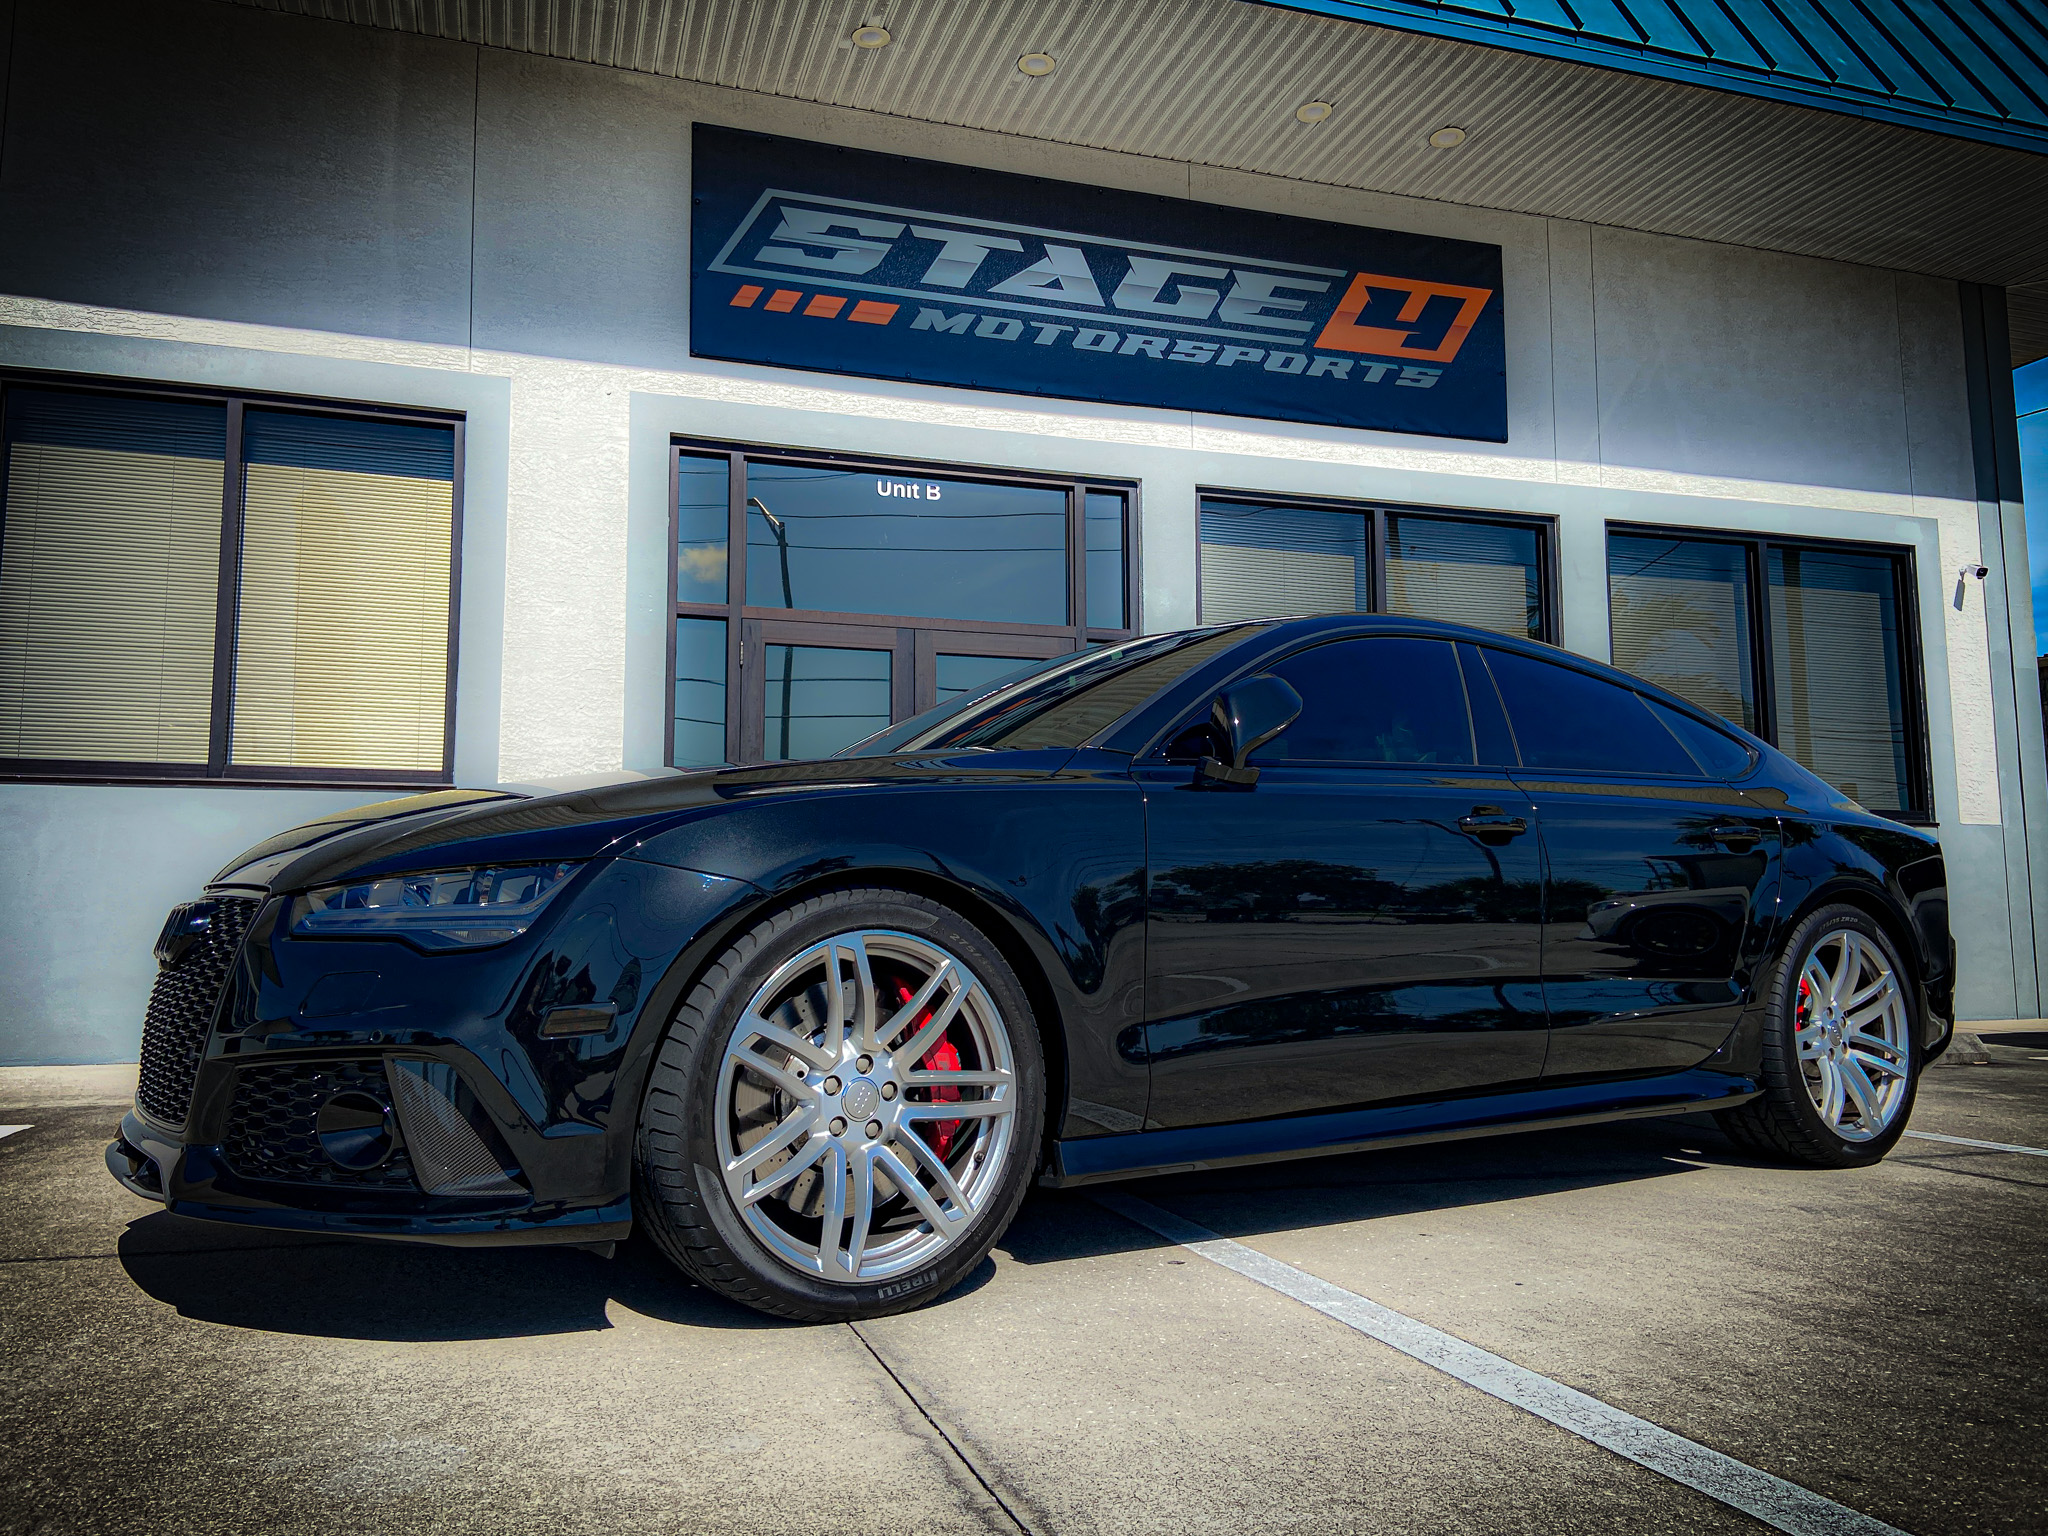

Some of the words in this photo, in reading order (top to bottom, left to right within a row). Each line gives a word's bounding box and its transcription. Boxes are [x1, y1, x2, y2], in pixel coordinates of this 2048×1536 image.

[754, 206, 1331, 332] STAGE
[910, 307, 1443, 389] MOTORSPORTS
[877, 479, 920, 499] Unit
[926, 482, 941, 500] B
[877, 1269, 939, 1299] PIRELLI
